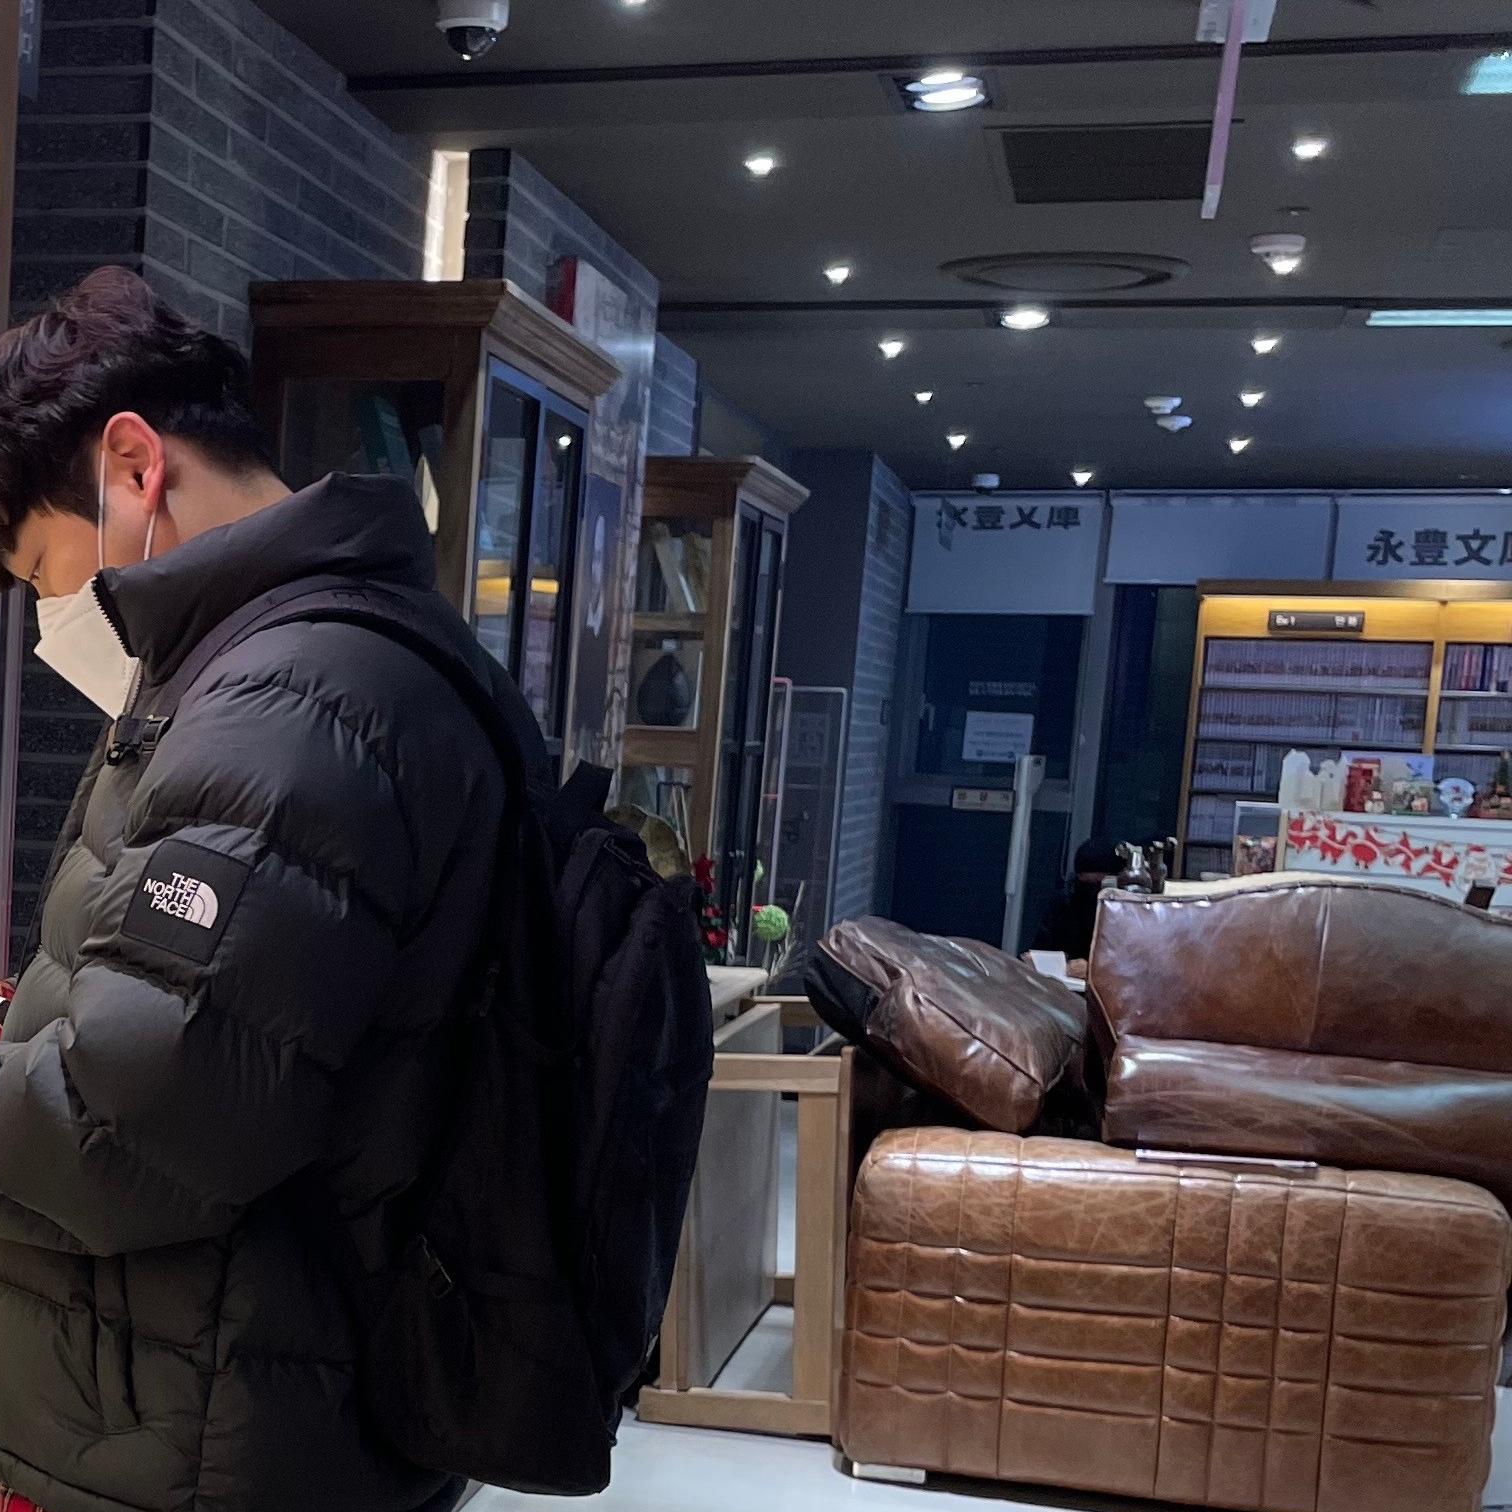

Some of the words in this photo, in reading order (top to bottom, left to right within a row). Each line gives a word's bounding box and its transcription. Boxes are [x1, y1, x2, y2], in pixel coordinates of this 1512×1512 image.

[143, 878, 195, 906] NORTH
[171, 871, 200, 894] THE
[150, 894, 188, 919] FACE
